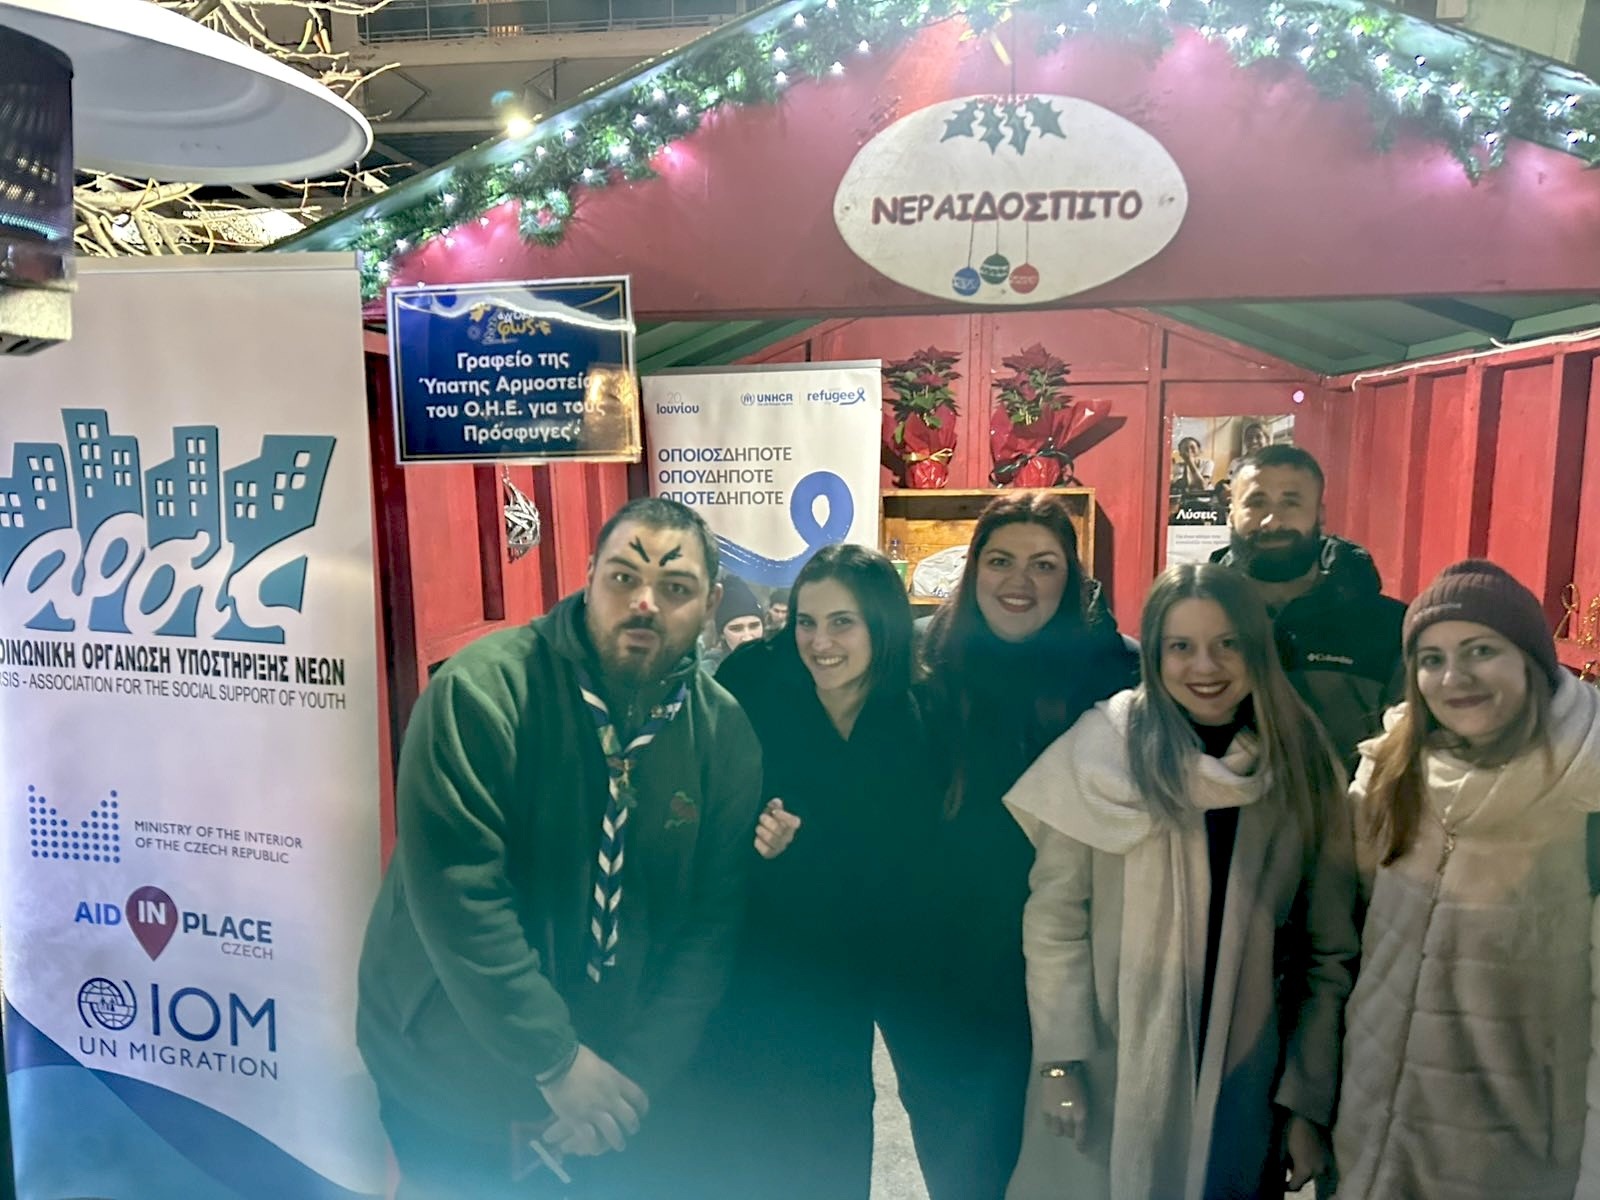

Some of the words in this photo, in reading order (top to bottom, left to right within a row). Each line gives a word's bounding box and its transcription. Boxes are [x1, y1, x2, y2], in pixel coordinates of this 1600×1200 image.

[872, 189, 1143, 225] ΝΕΡΑΙΔΟΣΠΙΤΟ
[456, 351, 533, 372] Γραφείο
[538, 352, 570, 368] της
[756, 393, 793, 402] UNHCR
[807, 389, 855, 403] refugee
[426, 405, 459, 418] του
[464, 400, 523, 417] Ο.Η.Ε.
[528, 401, 557, 418] για
[562, 400, 606, 415] τους
[656, 401, 700, 415] Ιουνίου
[463, 424, 571, 444] Πρόσφυγες
[658, 446, 792, 463] ΟΠΟΙΟΣΔΗΠΟΤΕ
[658, 468, 774, 484] ΟΠΟΥΔΗΠΟΤΕ
[1176, 508, 1218, 521] Λύσεις
[82, 642, 171, 673] ΟΡΓΑΝΩΣΗ
[177, 648, 289, 682] ΥΠΟΣΤΗΡΙΞΗΣ
[295, 656, 345, 686] ΝΕΩΝ
[0, 671, 20, 688] SIS
[29, 673, 113, 693] ASSOCIATION
[116, 677, 141, 695] FOR
[144, 679, 169, 697] THE
[172, 681, 217, 700] SOCIAL
[219, 684, 275, 705] SUPPORT
[278, 689, 296, 706] OF
[298, 690, 346, 710] YOUTH
[134, 820, 192, 836] MINISTRY
[196, 825, 214, 838] OF
[216, 827, 240, 841] THE
[244, 831, 303, 849] INTERIOR
[135, 837, 153, 849] OF
[156, 838, 180, 851] THE
[183, 841, 228, 856] CZECH
[231, 846, 289, 864] REPUBLIC
[74, 901, 121, 926] AID
[138, 900, 167, 926] IN
[182, 911, 272, 944] PLACE
[221, 942, 273, 960] CZECH
[150, 983, 277, 1052] IOM
[79, 1036, 117, 1057] UN
[130, 1043, 278, 1080] MIGRATION
